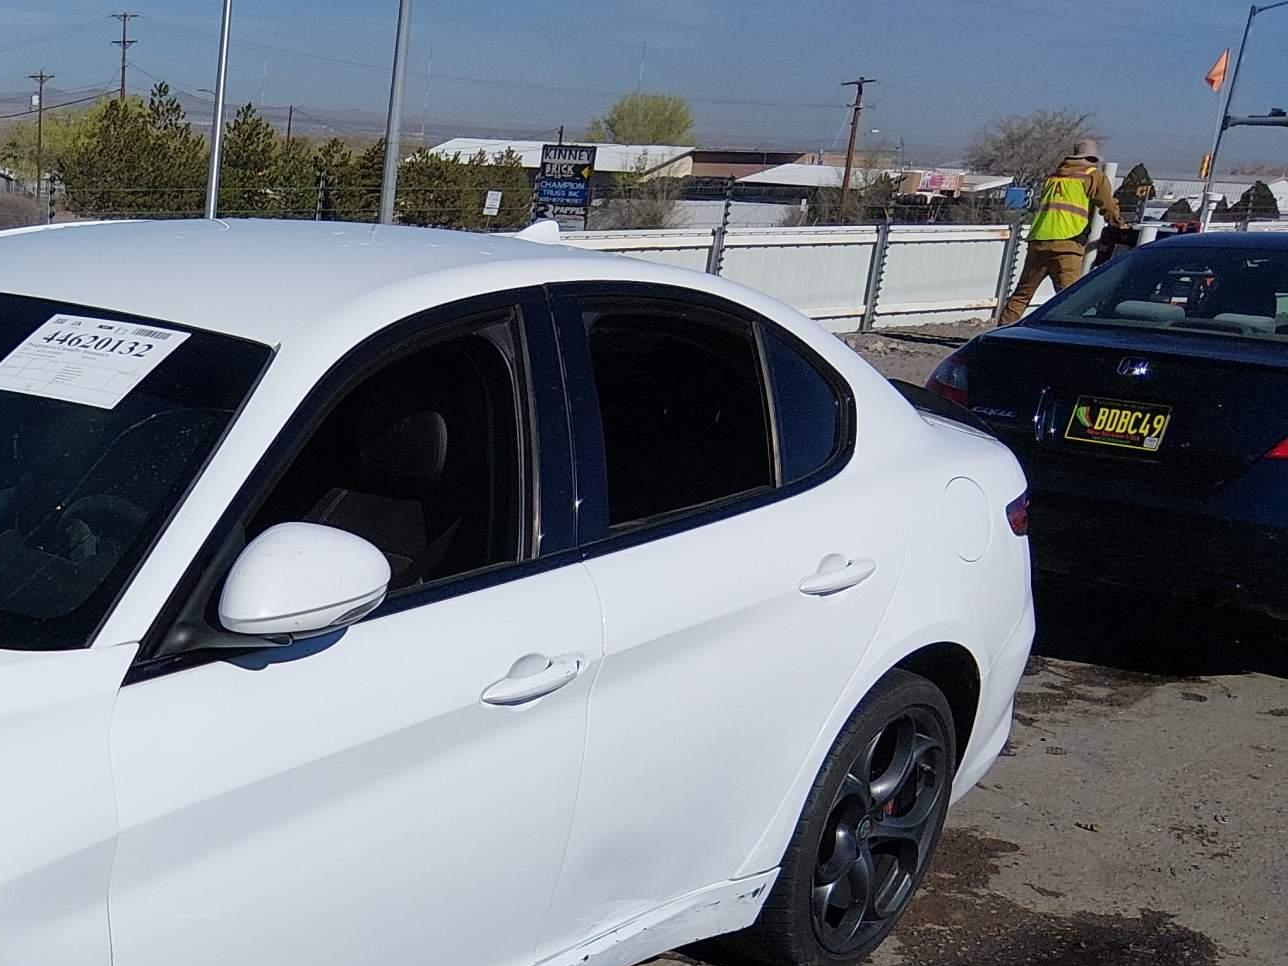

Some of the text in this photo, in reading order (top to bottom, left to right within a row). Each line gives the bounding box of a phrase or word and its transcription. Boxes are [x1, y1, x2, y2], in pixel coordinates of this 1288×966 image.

[544, 147, 592, 161] KINNEY
[545, 163, 575, 175] BRICK
[540, 180, 585, 190] CHAMPION
[43, 330, 154, 357] 44620132
[1093, 407, 1165, 438] BDBC49
